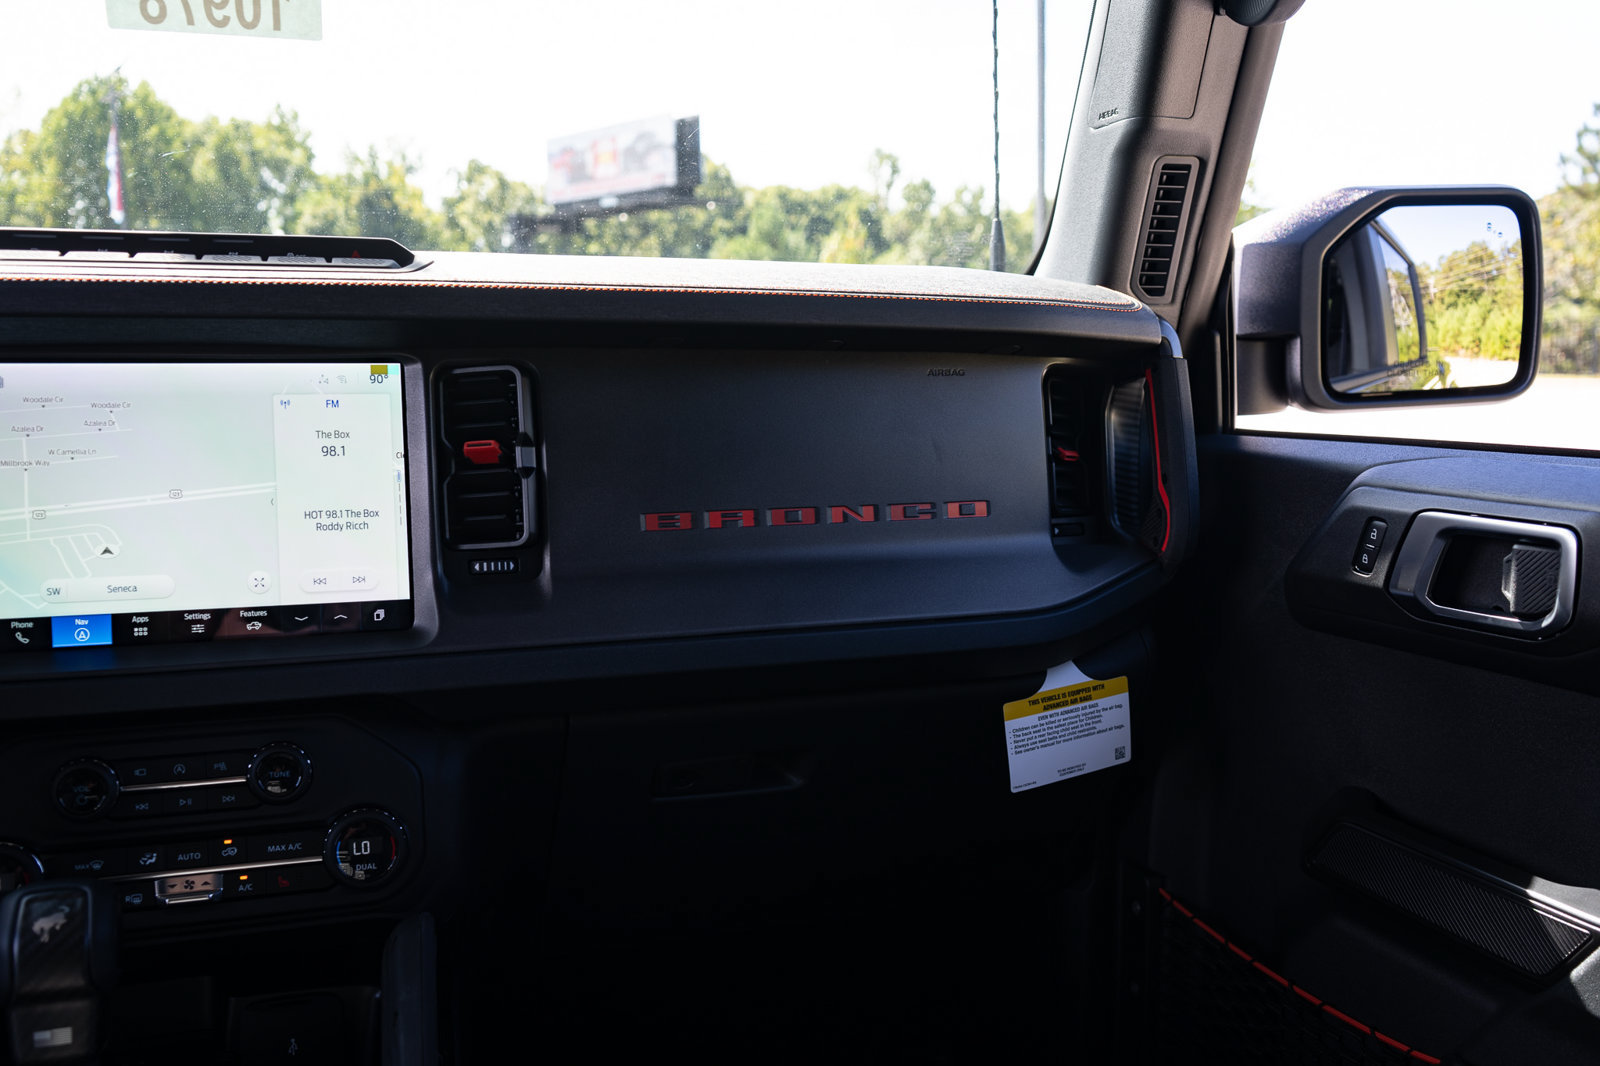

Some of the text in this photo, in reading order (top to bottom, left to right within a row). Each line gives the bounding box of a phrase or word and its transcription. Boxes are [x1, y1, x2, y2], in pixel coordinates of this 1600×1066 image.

[927, 368, 965, 377] AIRBAG
[326, 400, 340, 408] FM
[316, 430, 350, 438] The Box
[321, 446, 346, 456] 98.1
[304, 509, 380, 519] HOT 98.1 The Box
[640, 500, 990, 531] BRONCO
[316, 522, 369, 532] Roddy Ricch
[46, 584, 138, 596] SW Seneca
[10, 621, 34, 629] Phone
[132, 616, 150, 624] Apps
[184, 612, 211, 621] Settings
[240, 610, 268, 618] Features
[1041, 694, 1060, 703] VEHICLE
[1068, 687, 1091, 697] EQUIPPED
[1044, 700, 1069, 711] ADVANCED
[1060, 707, 1080, 716] ADVANCED
[268, 842, 302, 852] MAX A/C
[353, 840, 370, 856] LO
[178, 852, 201, 860] AUTO
[356, 863, 377, 871] DUAL
